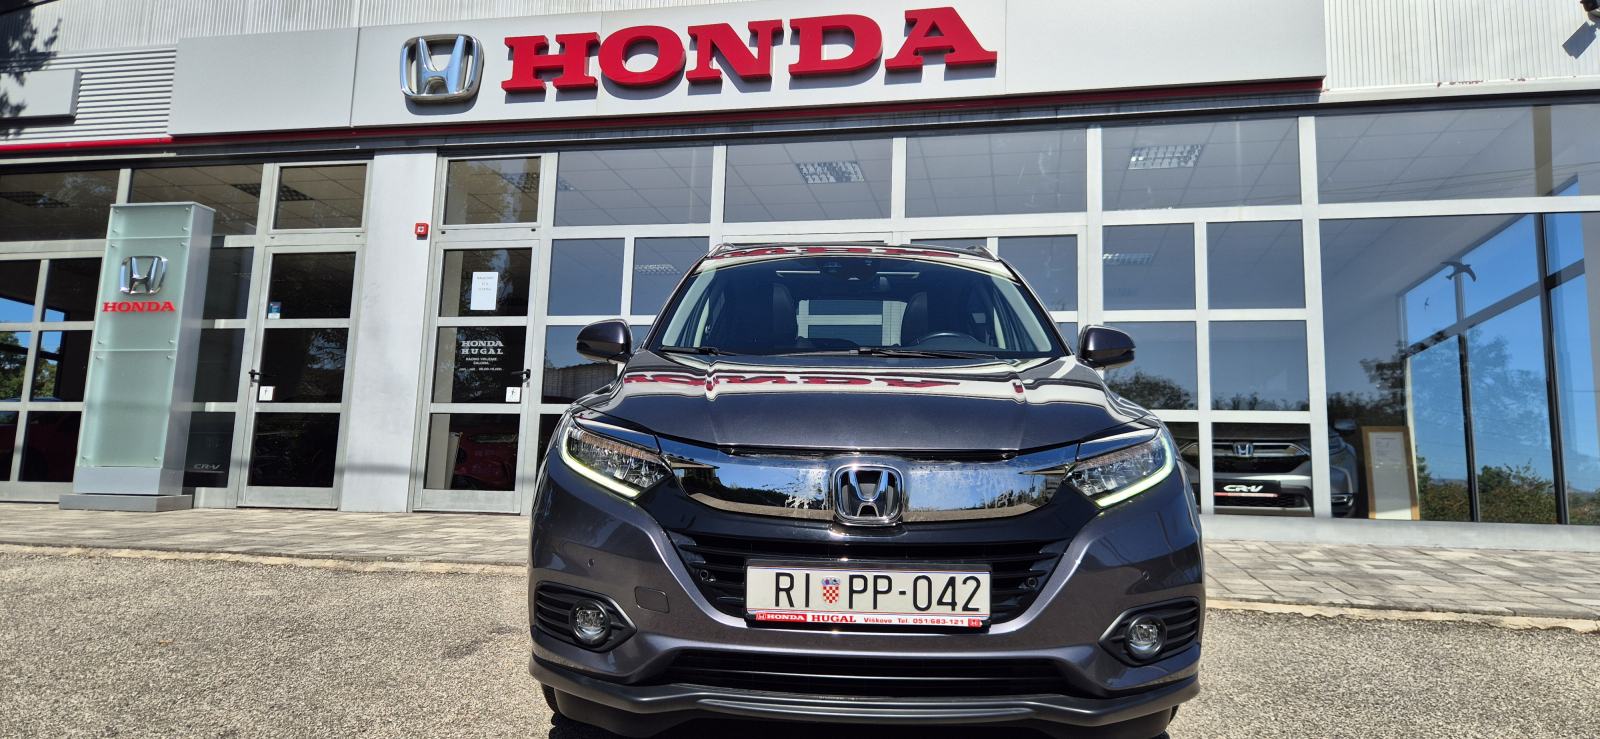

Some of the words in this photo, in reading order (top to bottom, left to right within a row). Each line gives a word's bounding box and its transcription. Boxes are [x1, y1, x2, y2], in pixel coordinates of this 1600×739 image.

[501, 6, 997, 94] HONDA
[102, 300, 176, 313] HONDA
[1223, 484, 1264, 493] CR-V
[774, 571, 811, 608] RI
[848, 573, 982, 612] PP-042
[767, 613, 805, 621] HONDA
[811, 614, 857, 623] HUGAL
